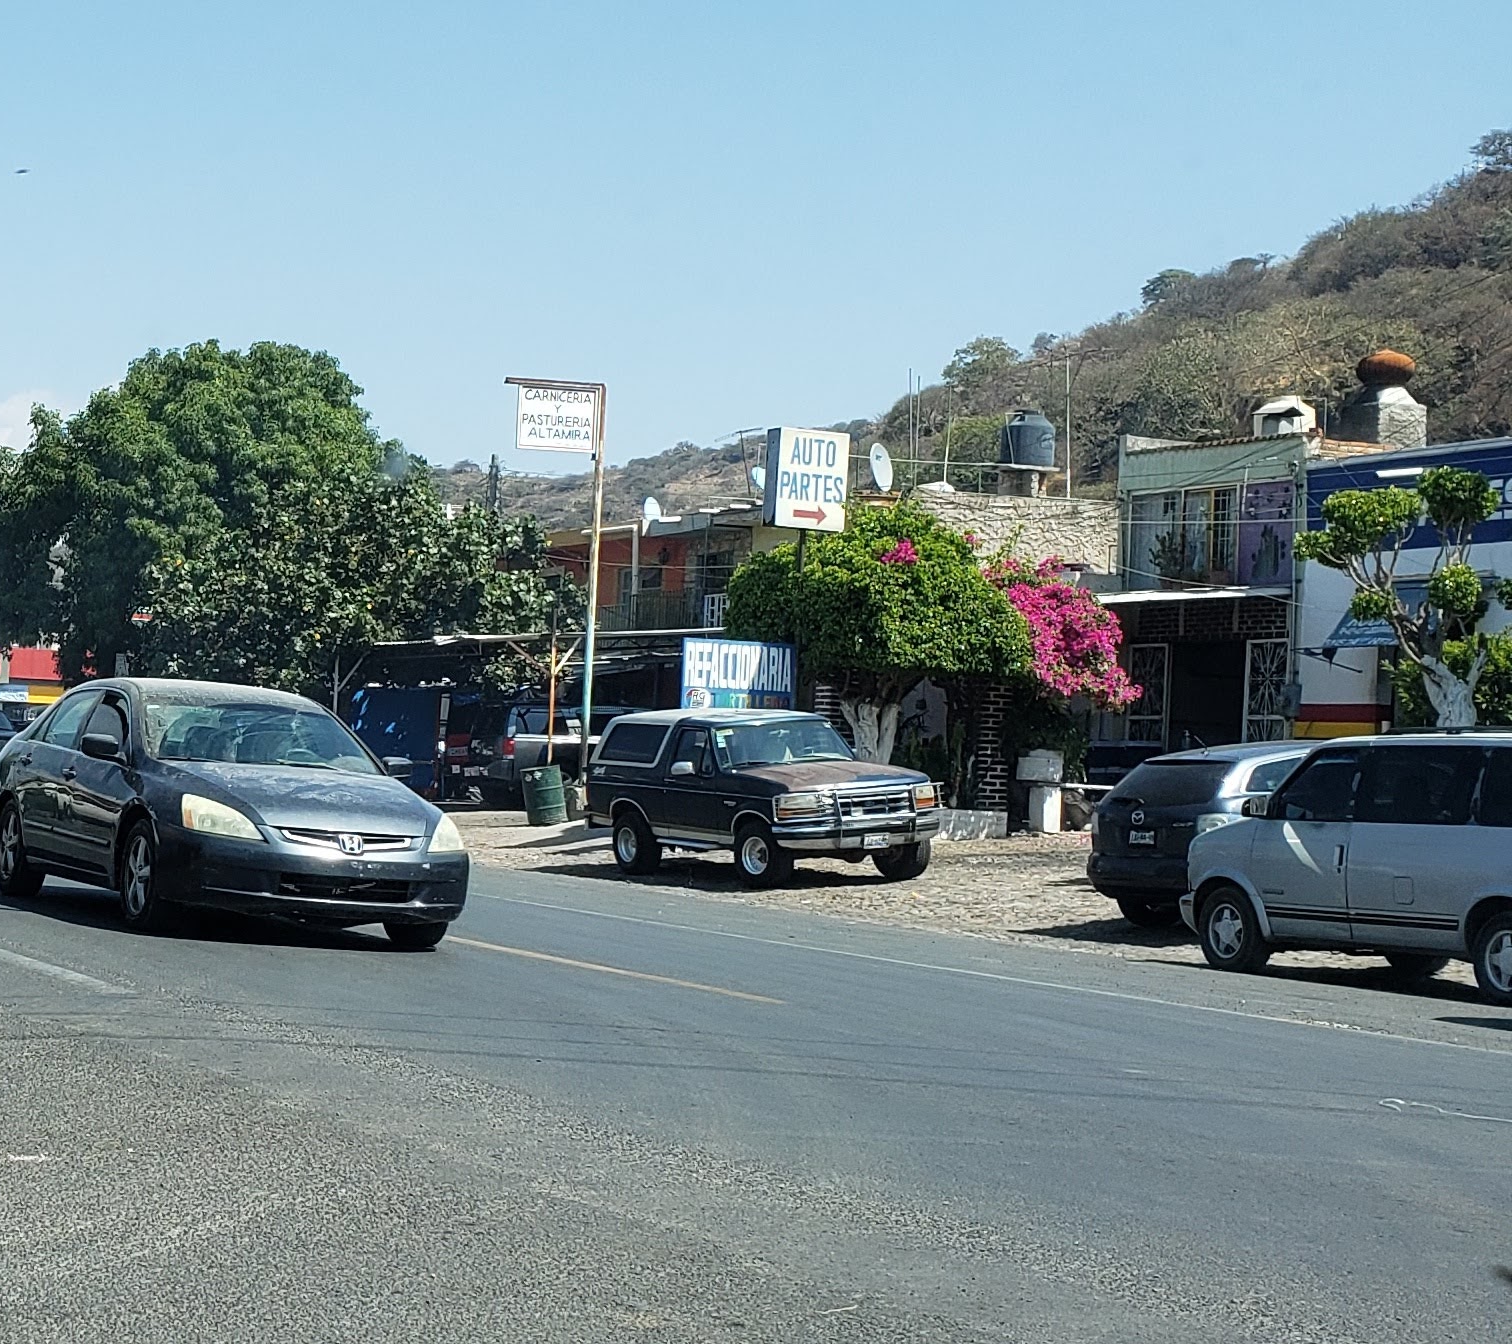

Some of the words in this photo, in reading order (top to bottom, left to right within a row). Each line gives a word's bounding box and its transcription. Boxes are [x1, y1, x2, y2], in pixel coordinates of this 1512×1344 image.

[524, 389, 592, 405] CARNICERIA
[554, 404, 562, 413] Y
[521, 413, 592, 429] PASTURERIA
[527, 427, 590, 442] ALTAMIRA
[790, 436, 837, 468] AUTO
[779, 470, 844, 504] PARTES
[684, 641, 791, 693] REFACCIONARIA
